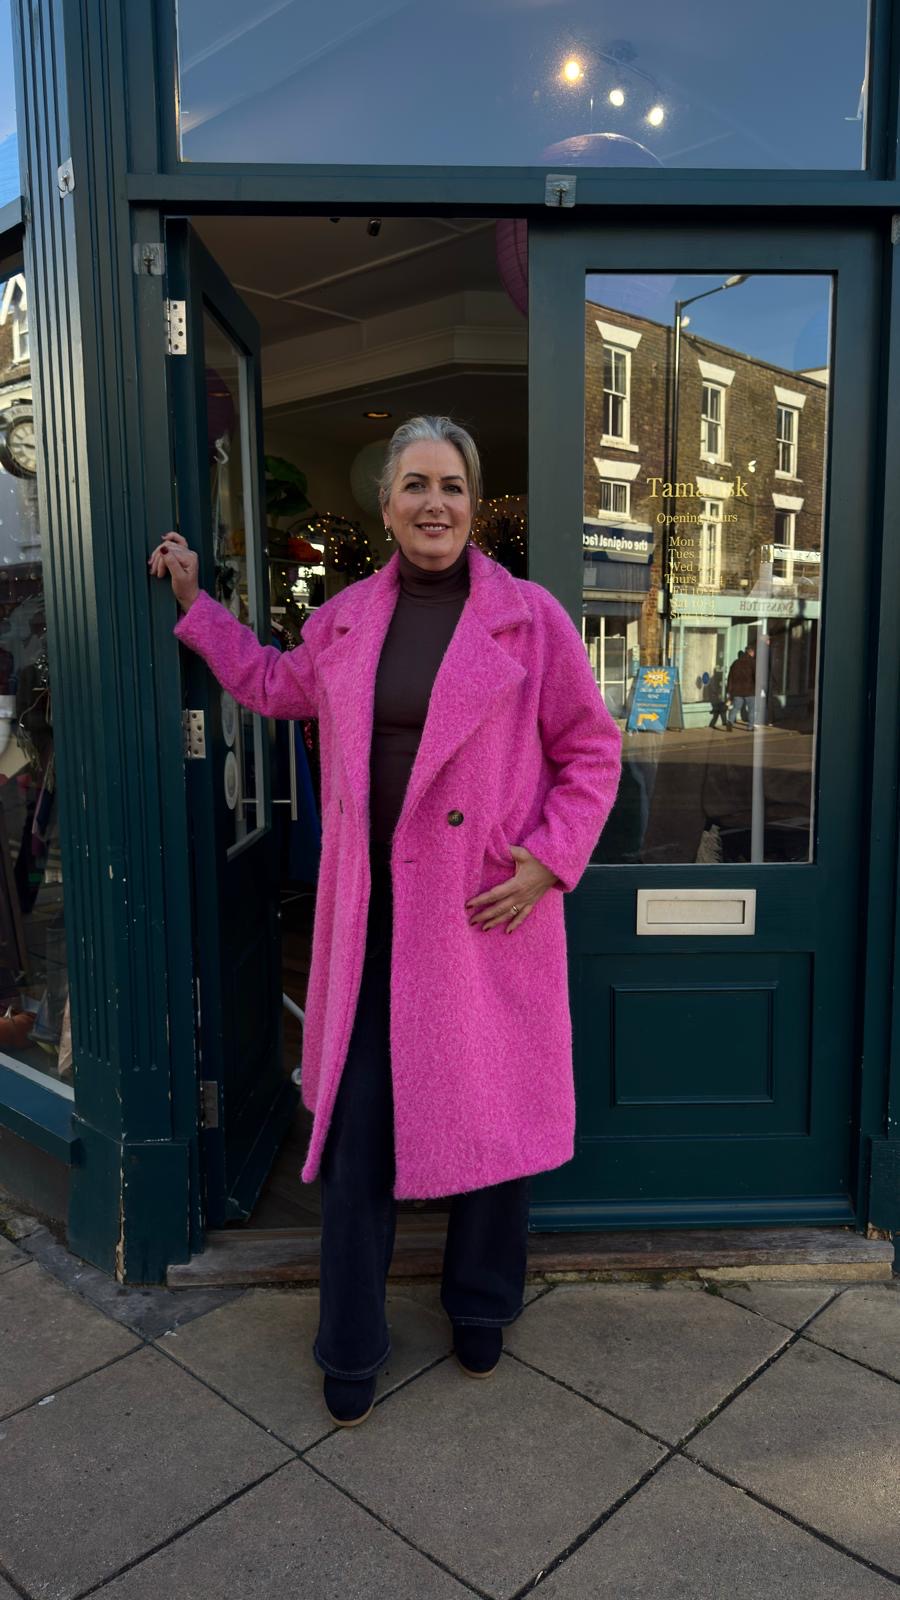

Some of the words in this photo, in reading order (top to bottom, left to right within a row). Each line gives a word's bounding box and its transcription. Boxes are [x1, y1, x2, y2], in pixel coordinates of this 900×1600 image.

[656, 512, 702, 525] Opening
[705, 513, 738, 523] urs
[668, 536, 694, 547] Mon
[667, 548, 695, 559] Tues
[668, 561, 693, 572] Wed
[664, 573, 697, 584] Thurs
[670, 610, 688, 620] Su
